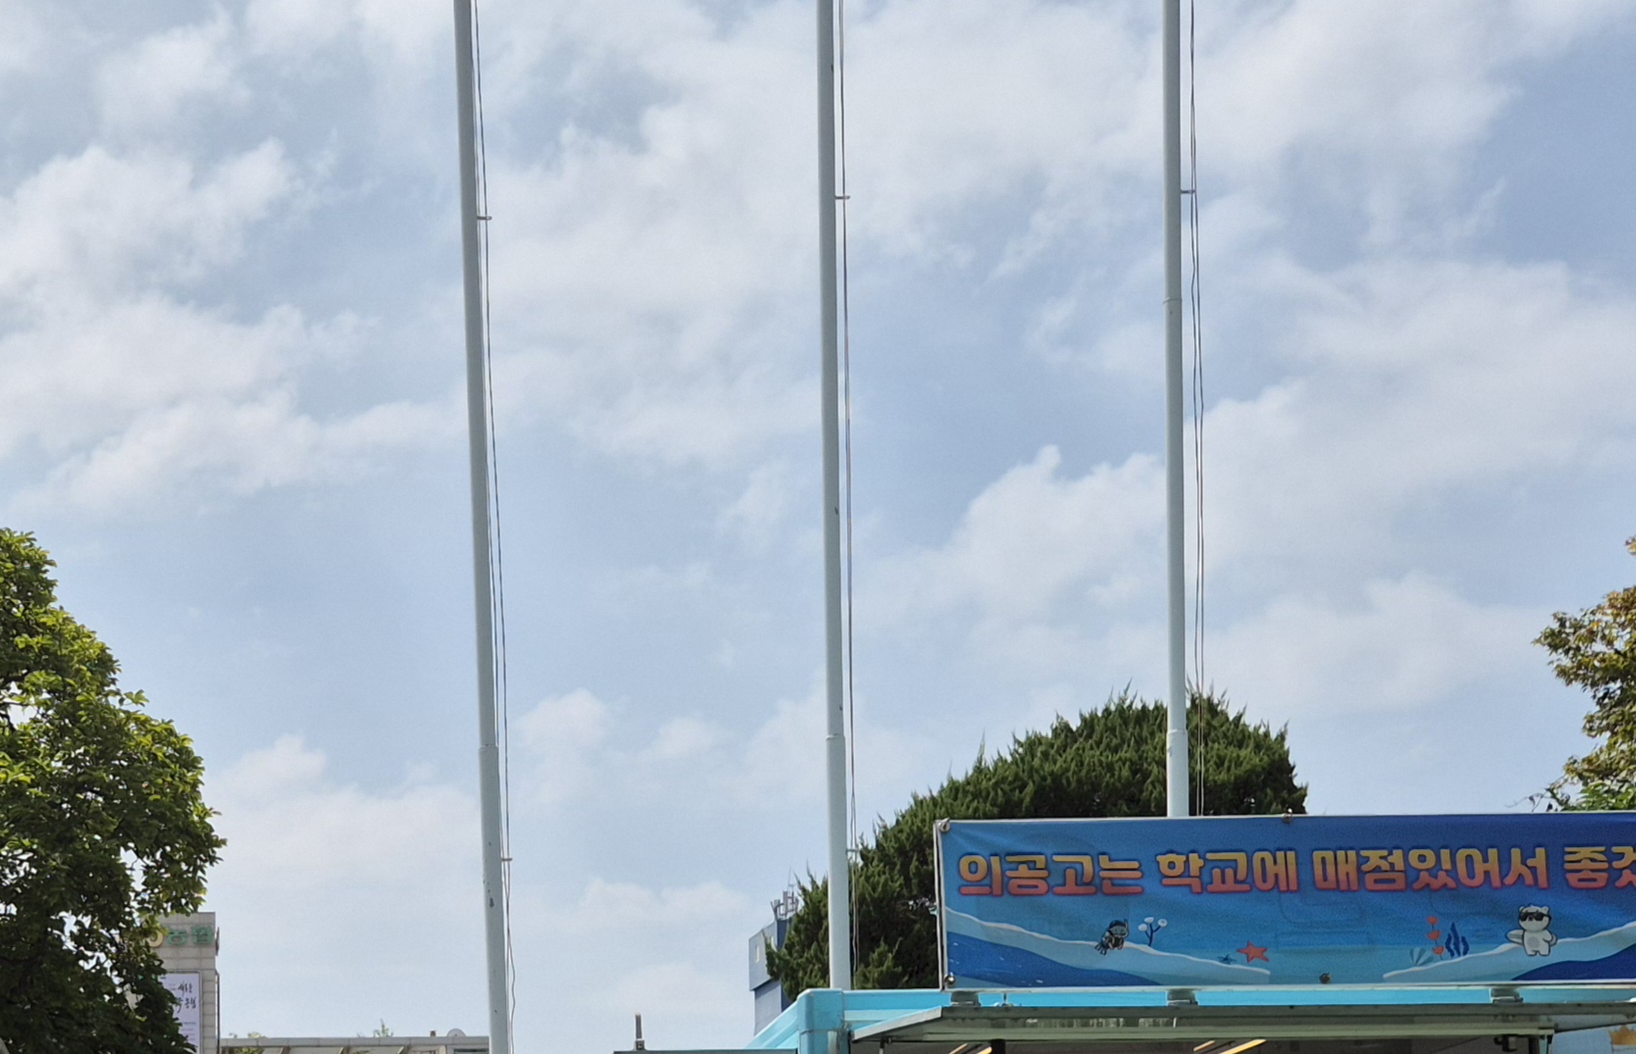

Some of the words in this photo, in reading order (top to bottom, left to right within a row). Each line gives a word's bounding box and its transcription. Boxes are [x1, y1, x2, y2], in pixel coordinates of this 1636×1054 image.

[959, 852, 1144, 896] 의공고는
[1156, 851, 1298, 893] 학교에
[1312, 847, 1549, 891] 매점있어서
